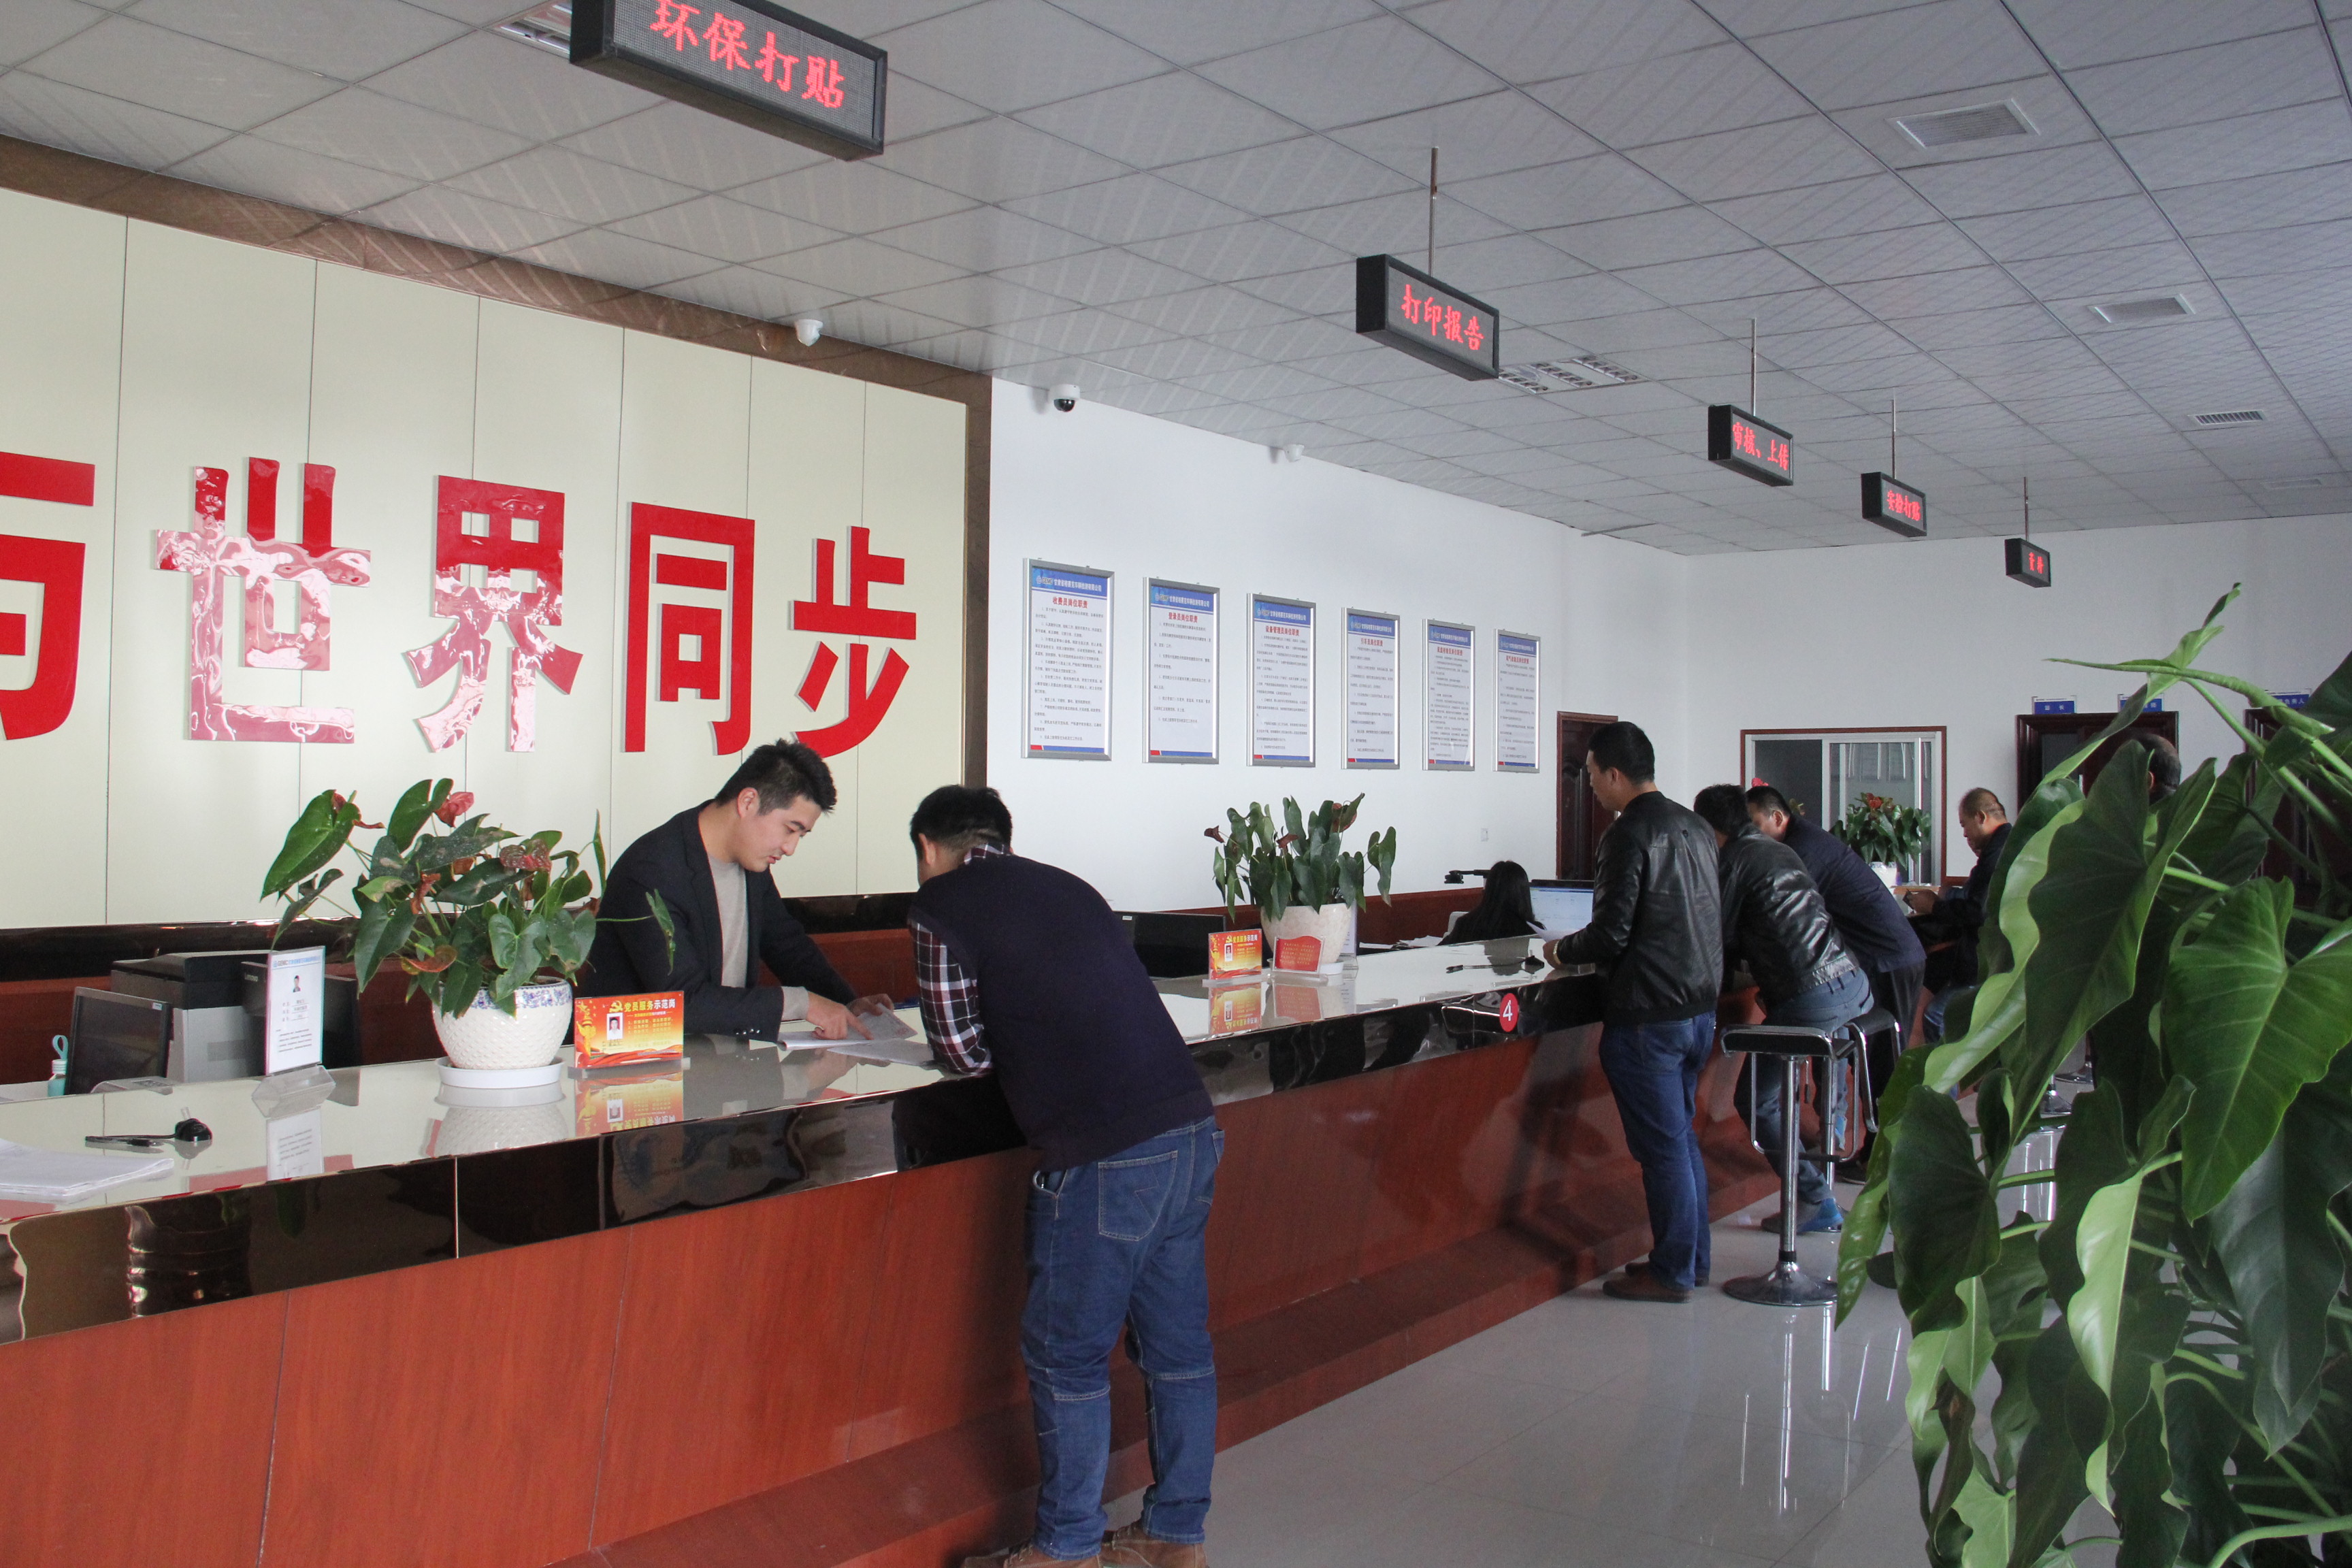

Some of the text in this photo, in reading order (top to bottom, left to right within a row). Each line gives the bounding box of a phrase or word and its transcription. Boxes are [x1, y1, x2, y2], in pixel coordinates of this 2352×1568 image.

[649, 0, 846, 109] 环保打贴
[1400, 284, 1485, 350] 打印报告
[623, 998, 676, 1013] 党员服务示范岗
[1502, 1000, 1513, 1022] 4
